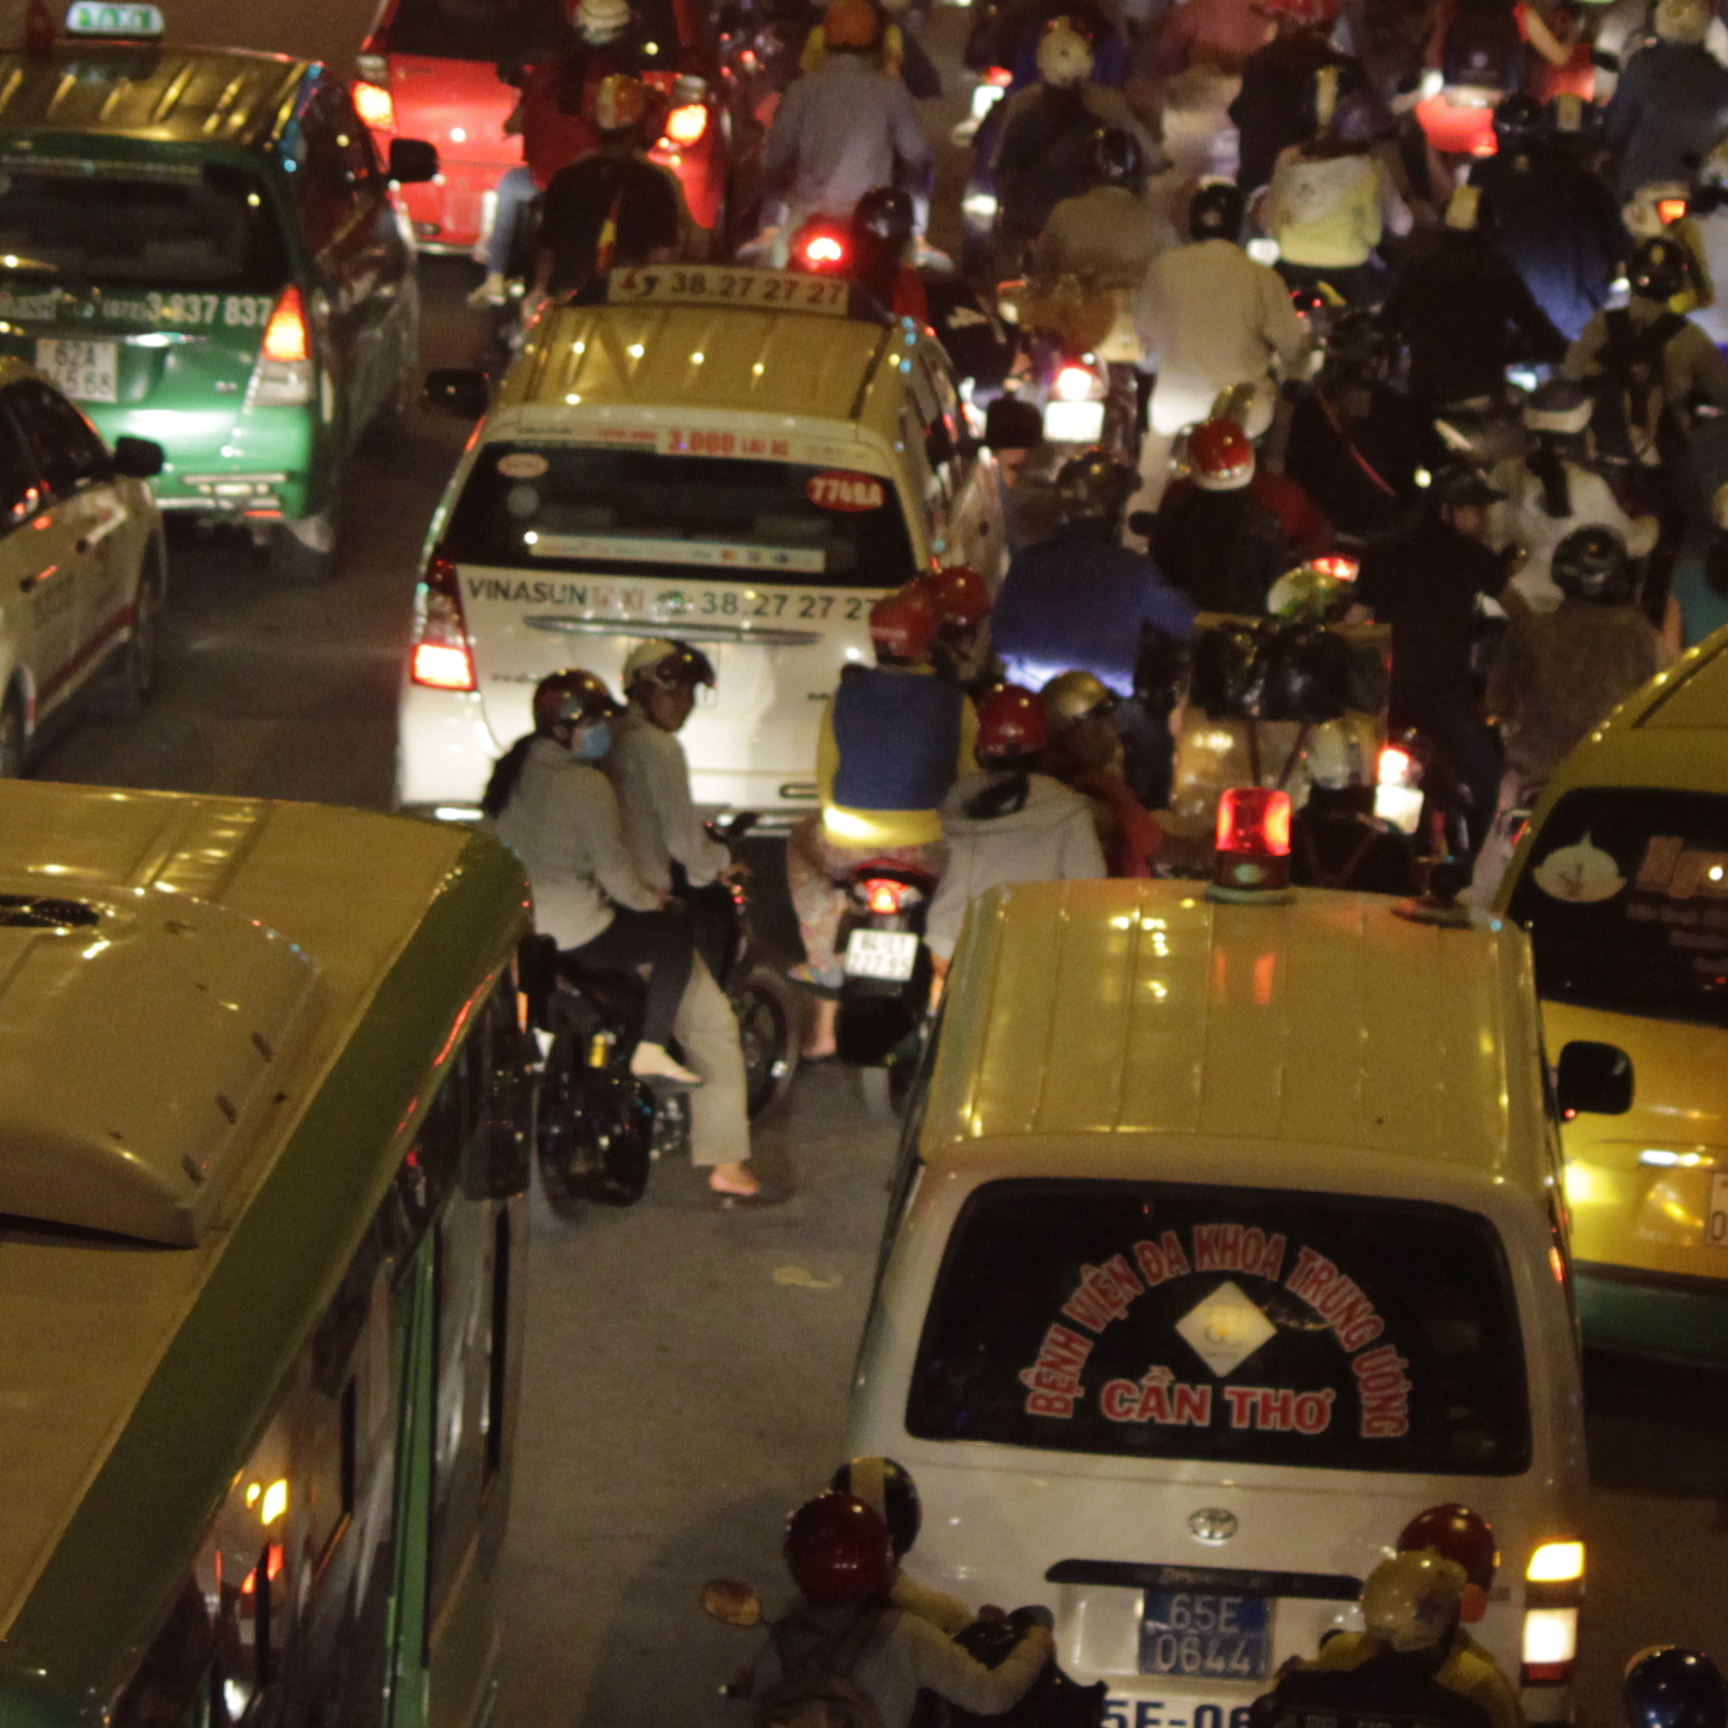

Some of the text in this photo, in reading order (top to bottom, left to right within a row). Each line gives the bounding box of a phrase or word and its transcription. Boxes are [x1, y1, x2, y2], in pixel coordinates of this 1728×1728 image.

[762, 278, 796, 302] 27
[807, 280, 844, 305] 27
[468, 577, 588, 605] VINASUN
[798, 595, 834, 619] 27
[1019, 1322, 1094, 1419] BỆNH
[1061, 1253, 1145, 1334] VIỆN
[1133, 1229, 1191, 1286] ĐA
[1192, 1223, 1287, 1282] KHOA
[1285, 1244, 1385, 1353] TRUNG
[1100, 1364, 1337, 1435] CẦN THƠ
[1171, 1593, 1243, 1634] 65E
[1154, 1633, 1252, 1674] 0644
